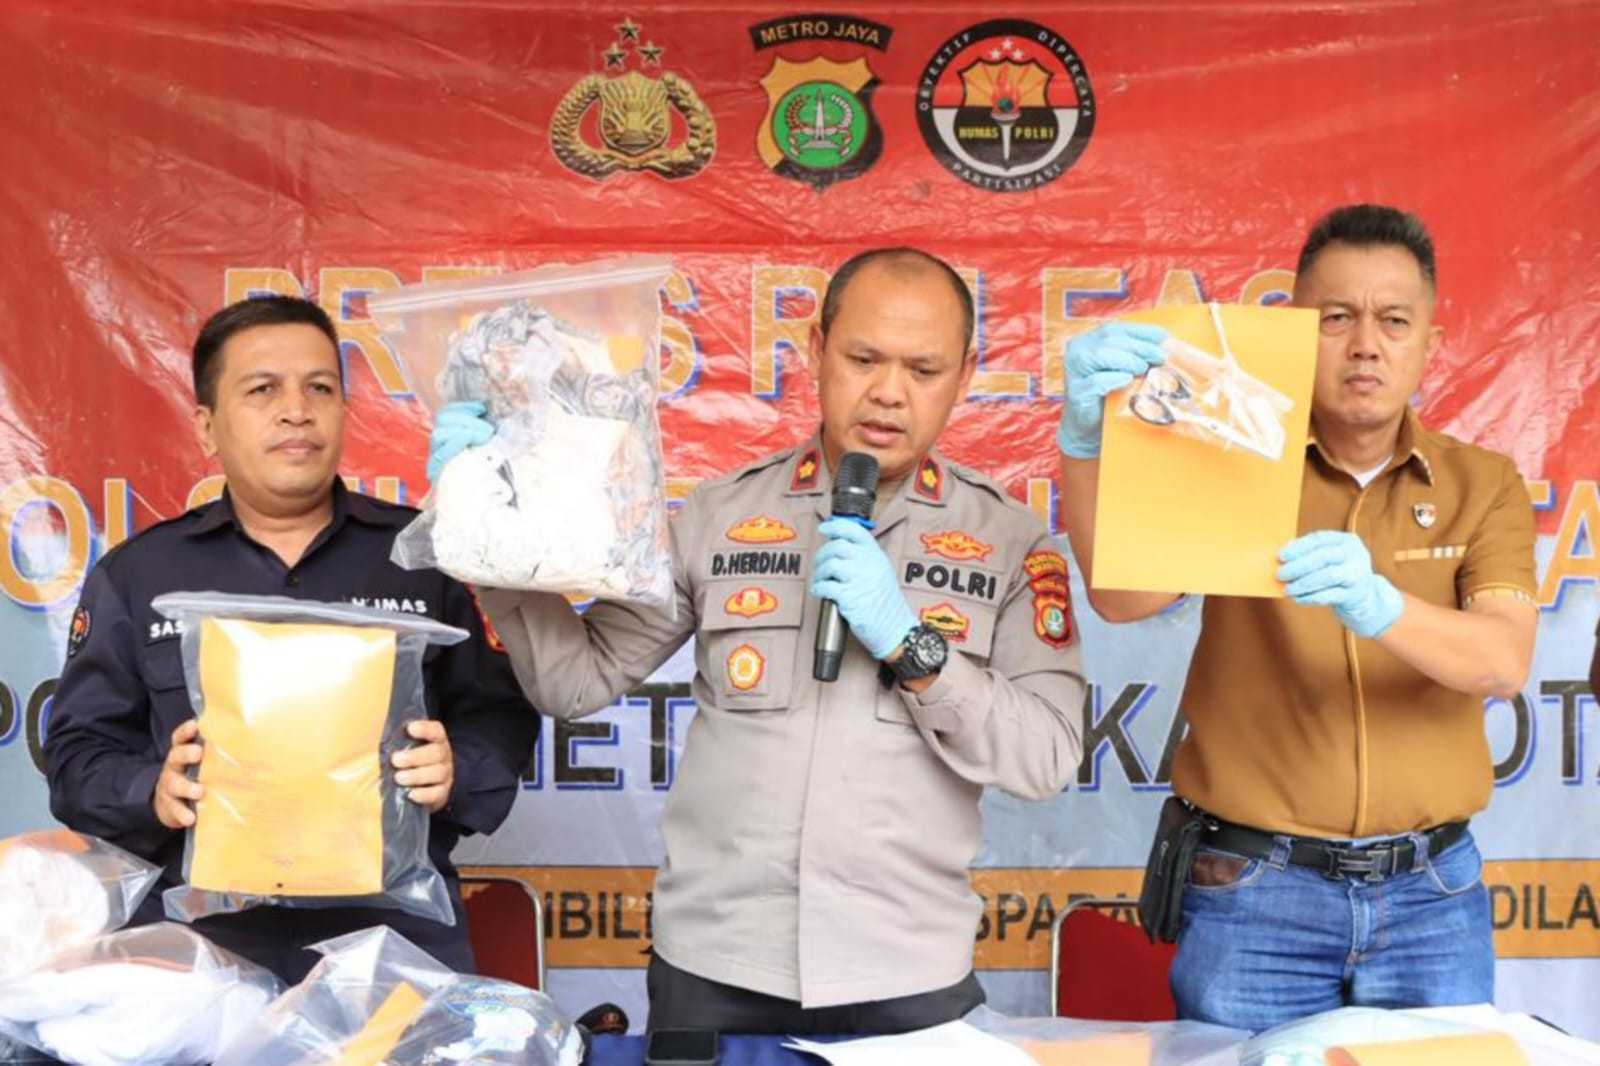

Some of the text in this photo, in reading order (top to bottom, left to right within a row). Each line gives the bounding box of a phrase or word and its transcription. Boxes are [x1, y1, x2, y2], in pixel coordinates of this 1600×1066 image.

[760, 21, 880, 44] METRO JAYA
[958, 126, 1054, 139] HUMAS POLRI
[711, 551, 801, 576] D.HERDIAN
[904, 561, 997, 600] POLRI
